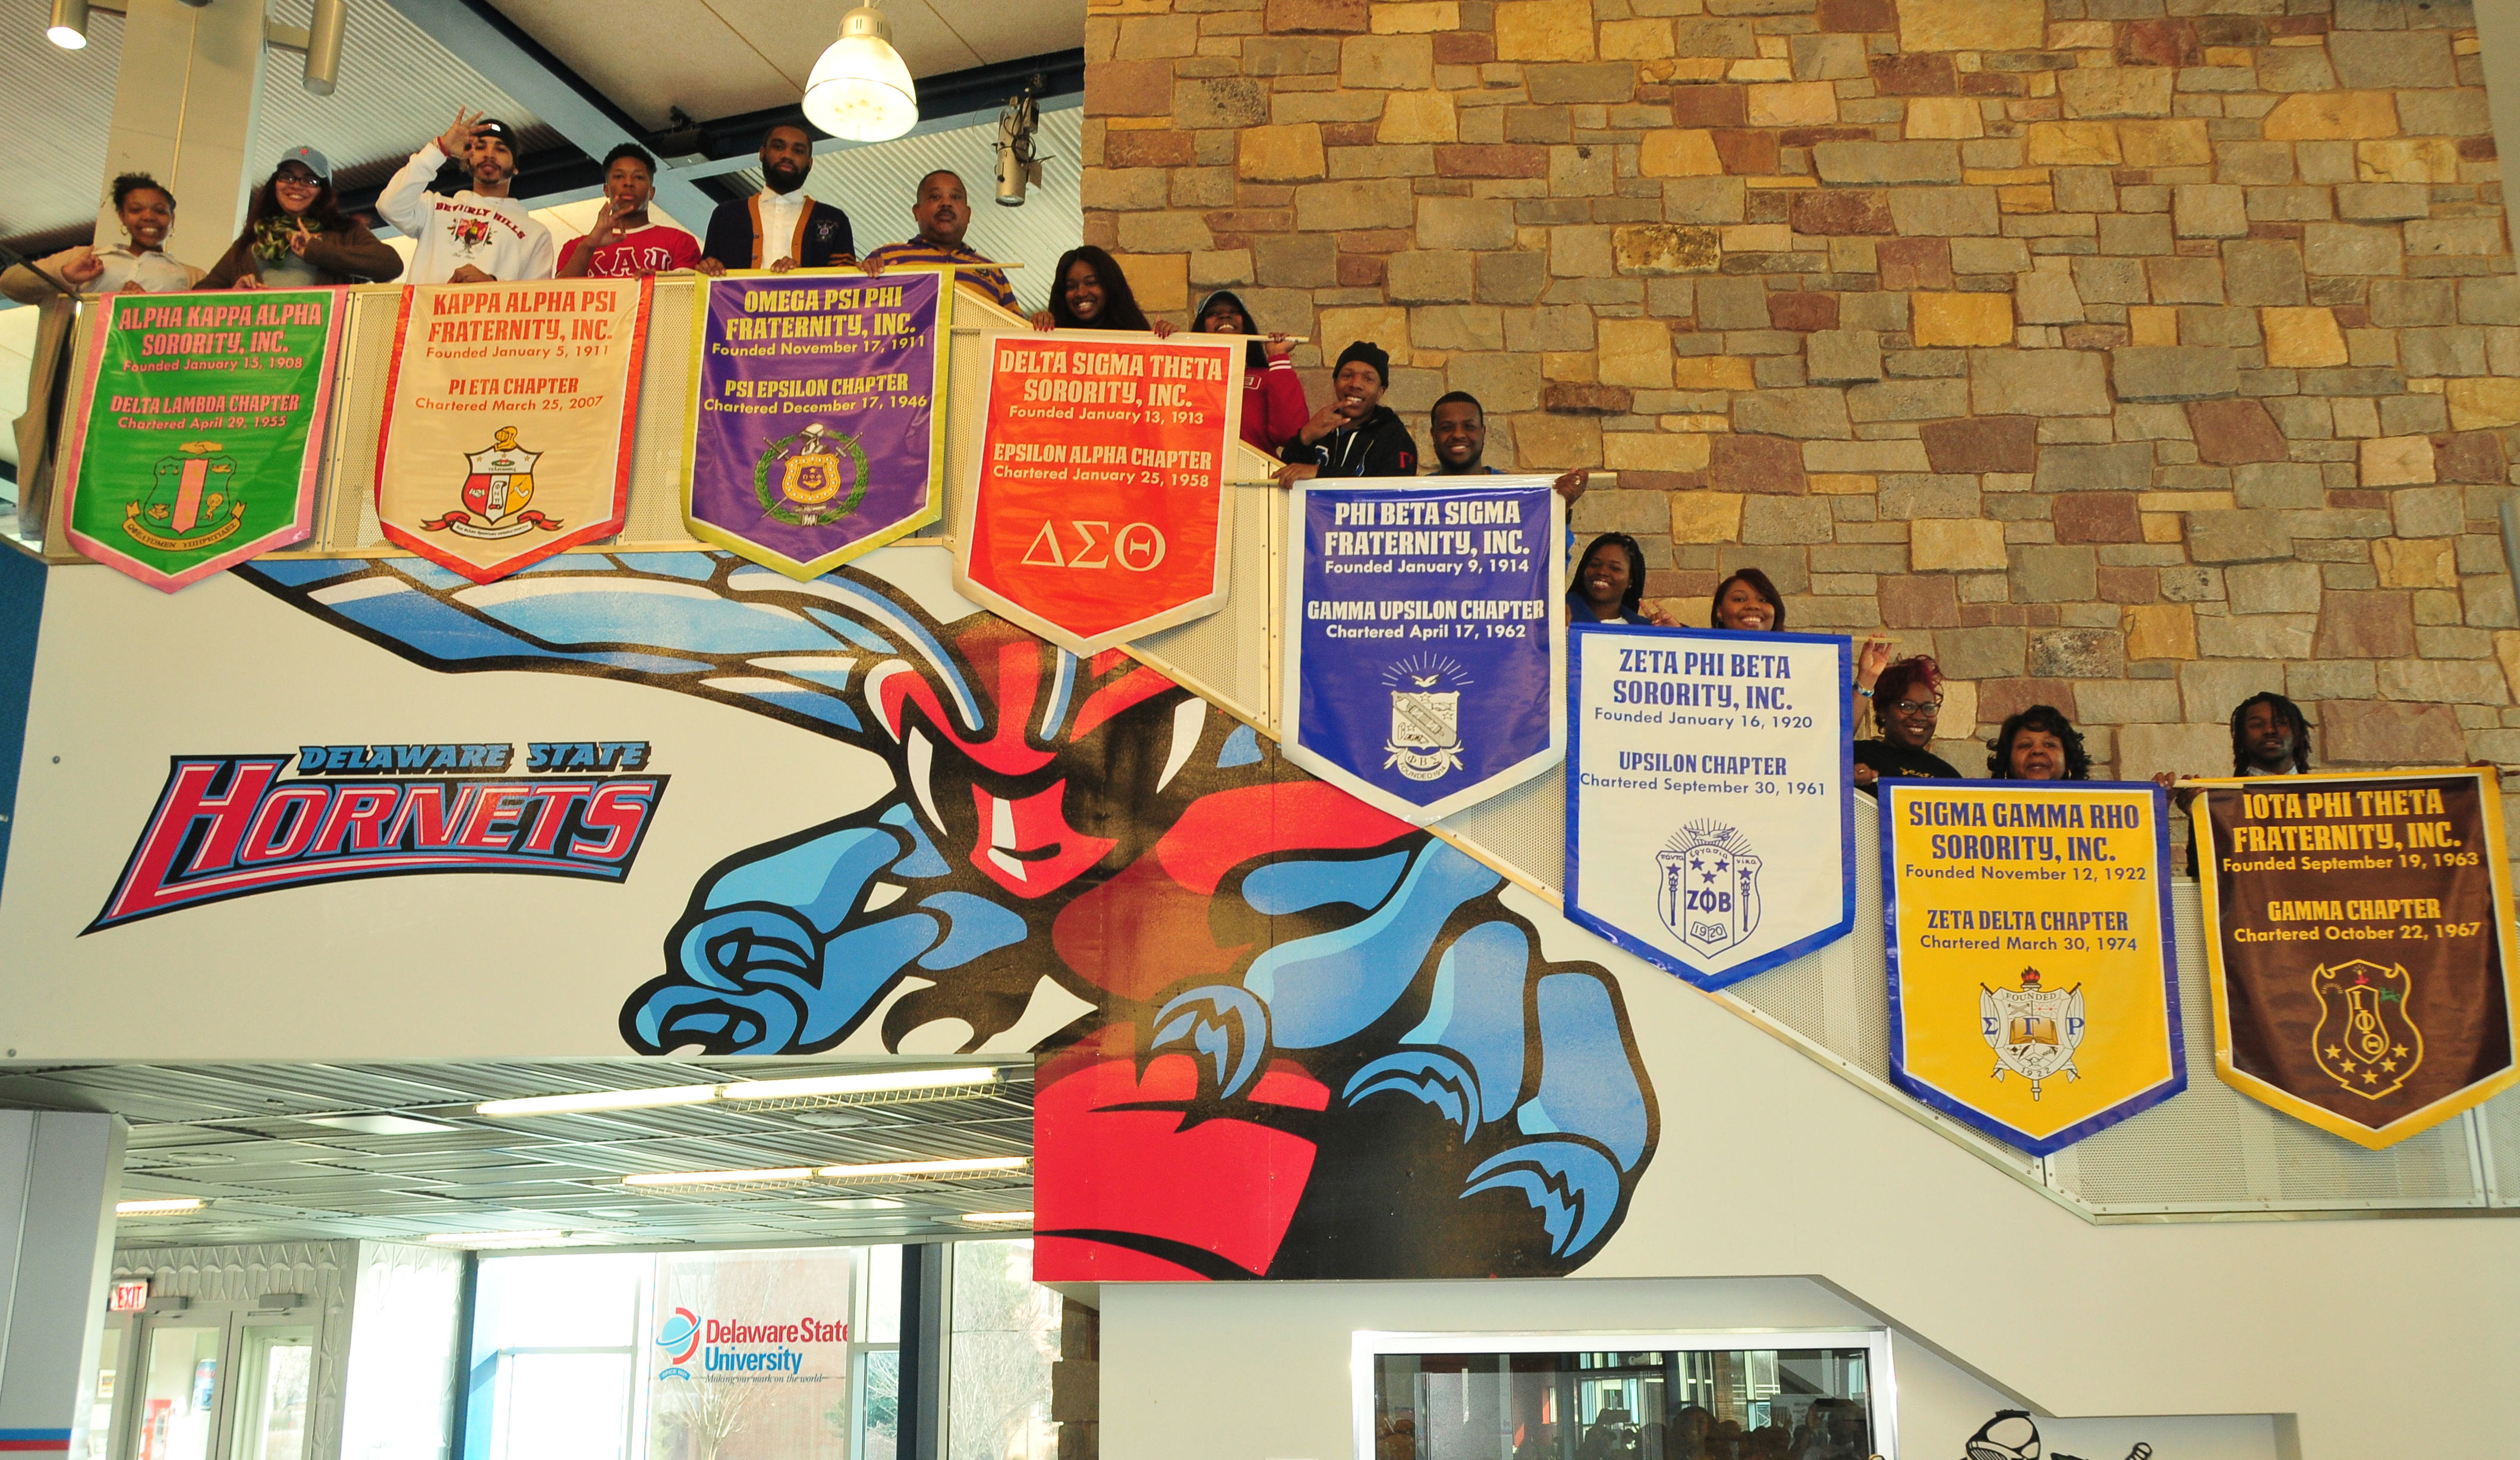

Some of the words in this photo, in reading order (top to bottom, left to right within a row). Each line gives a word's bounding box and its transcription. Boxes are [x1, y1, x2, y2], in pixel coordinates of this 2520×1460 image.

[435, 202, 492, 216] BEVERLY
[493, 212, 526, 240] HILLS
[433, 292, 500, 315] KAPPA
[506, 291, 575, 312] ALPHA
[581, 291, 616, 312] PSI
[745, 290, 818, 312] OMEGA
[824, 289, 860, 310] PSI
[864, 287, 902, 308] PHI
[118, 307, 183, 330] ALPHA
[186, 306, 252, 327] KAPPA
[255, 303, 321, 326] ALPHA
[726, 314, 868, 340] FRATERNITY,
[874, 313, 915, 335] INC.
[429, 319, 565, 342] FRATERNITY,
[572, 319, 612, 341] INC.
[142, 332, 245, 356] SORORITY,
[250, 331, 289, 353] INC.
[427, 347, 487, 358] Founded
[493, 346, 550, 359] January
[556, 346, 568, 358] 5,
[577, 346, 607, 356] 1911
[713, 343, 776, 356] Founded
[781, 341, 857, 354] November
[864, 341, 884, 353] 17,
[892, 335, 924, 350] 1911
[123, 359, 180, 373] Founded
[184, 358, 238, 372] January
[244, 357, 263, 370] 15,
[270, 357, 303, 369] 1908
[999, 350, 1066, 373] DELTA
[1072, 353, 1144, 376] SIGMA
[1150, 355, 1221, 380] THETA
[449, 380, 466, 395] PI
[469, 379, 499, 395] ETA
[504, 378, 578, 394] CHAPTER
[725, 380, 754, 398] PSI
[757, 379, 828, 397] EPSILON
[832, 373, 908, 395] CHAPTER
[1024, 379, 1142, 407] SORORITY,
[1148, 384, 1192, 407] INC.
[110, 395, 160, 414] DELTA
[163, 395, 226, 414] LAMBDA
[229, 394, 300, 413] CHAPTER
[415, 398, 487, 411] Chartered
[492, 399, 536, 410] March
[542, 399, 562, 411] 25,
[569, 395, 603, 409] 2007
[704, 398, 777, 414] Chartered
[783, 399, 856, 413] December
[862, 397, 883, 409] 17,
[891, 396, 927, 407] 1946
[118, 417, 187, 430] Chartered
[190, 417, 223, 431] April
[228, 416, 247, 429] 29,
[254, 415, 286, 427] 1955
[1010, 405, 1073, 419] Founded
[1079, 408, 1141, 423] January
[1145, 411, 1164, 425] 13,
[1172, 411, 1203, 424] 1913
[994, 443, 1066, 462] EPSILON
[1069, 446, 1127, 464] ALPHA
[1132, 448, 1211, 470] CHAPTER
[994, 465, 1067, 479] Chartered
[1073, 468, 1135, 484] January
[1141, 471, 1164, 486] 25,
[1172, 474, 1208, 487] 1958
[1335, 503, 1375, 525] PHI
[1380, 502, 1439, 525] BETA
[1445, 501, 1520, 524] SIGMA
[1021, 520, 1166, 571] ΔΣΘ
[1325, 531, 1478, 557] FRATERNITY,
[1483, 530, 1529, 554] INC.
[1325, 559, 1392, 573] Founded
[1398, 559, 1463, 575] January
[1468, 559, 1482, 574] 9,
[1490, 559, 1529, 572] 1914
[1308, 601, 1376, 620] GAMMA
[1380, 600, 1457, 620] UPSILON
[1461, 600, 1544, 619] CHAPTER
[1327, 625, 1404, 638] Chartered
[1410, 624, 1448, 641] April
[1456, 625, 1479, 640] 17,
[1486, 625, 1525, 637] 1962
[1620, 649, 1678, 674] ZETA
[1685, 652, 1724, 676] PHI
[1731, 654, 1790, 678] BETA
[1614, 680, 1739, 711] SORORITY,
[1747, 686, 1792, 710] INC.
[1595, 707, 1662, 723] Founded
[1669, 712, 1734, 729] January
[1742, 715, 1764, 729] 16,
[1773, 716, 1812, 728] 1920
[298, 742, 512, 775] DELAWARE
[527, 741, 652, 772] STATE
[1620, 751, 1696, 772] UPSILON
[1702, 756, 1786, 775] CHAPTER
[1399, 762, 1432, 779] FOUNDED
[1580, 773, 1657, 789] Chartered
[1664, 778, 1749, 794] September
[1755, 782, 1779, 796] 30,
[1788, 782, 1823, 795] 1961
[1910, 801, 1987, 826] SIGMA
[1993, 803, 2084, 828] GAMMA
[2090, 805, 2139, 829] RHO
[2243, 794, 2303, 819] IOTA
[2307, 792, 2352, 818] PHI
[2357, 789, 2445, 816] THETA
[90, 756, 661, 925] HORNETS
[2233, 824, 2402, 852] FRATERNITY,
[2406, 822, 2461, 848] INC.
[1932, 835, 2061, 864] SORORITY,
[2068, 837, 2115, 861] INC.
[1907, 864, 1974, 878] Founded
[1982, 866, 2066, 880] November
[2074, 868, 2097, 882] 12,
[2106, 867, 2146, 880] 1922
[2223, 857, 2296, 872] Founded
[2301, 855, 2393, 873] September
[2399, 854, 2427, 869] 19,
[2433, 852, 2478, 866] 1963
[1928, 910, 1974, 929] ZETA
[1979, 911, 2036, 930] DELTA
[2041, 911, 2128, 930] CHAPTER
[2268, 901, 2344, 921] GAMMA
[2346, 899, 2441, 920] CHAPTER
[1694, 924, 1724, 938] 1920
[2234, 926, 2319, 942] Chartered
[2325, 926, 2394, 940] October
[2400, 925, 2428, 940] 22,
[2436, 922, 2481, 937] 1967
[1921, 935, 1999, 949] Chartered
[2007, 937, 2057, 950] March
[2064, 937, 2089, 952] 30,
[2098, 937, 2137, 951] 1974
[2006, 992, 2056, 1001] FOUNDED
[2021, 1067, 2051, 1077] 1922
[118, 1286, 143, 1308] EXIT
[706, 1319, 798, 1343] Delaware
[705, 1346, 802, 1374] University
[705, 1374, 735, 1385] Making
[752, 1374, 773, 1383] mark
[786, 1374, 799, 1383] the
[800, 1374, 823, 1383] world
